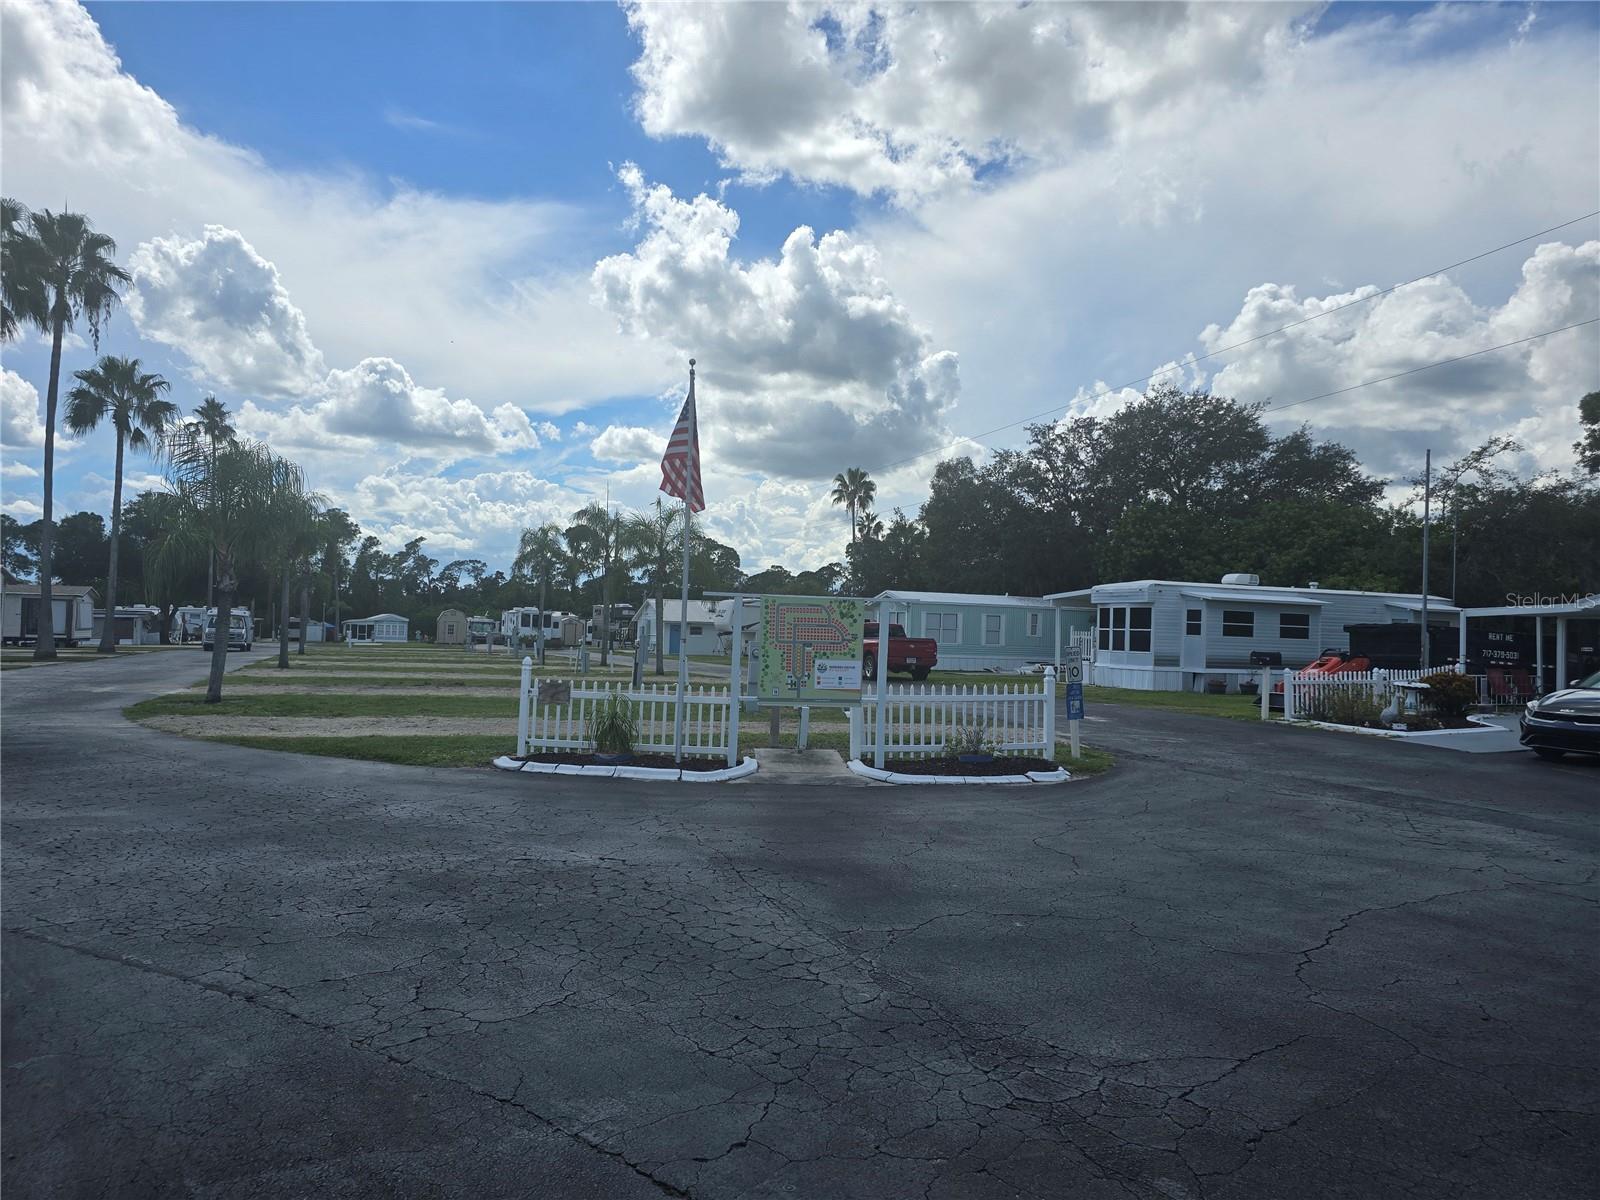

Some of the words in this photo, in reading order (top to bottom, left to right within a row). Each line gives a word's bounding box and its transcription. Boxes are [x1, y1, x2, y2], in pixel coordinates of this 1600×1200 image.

[1488, 633, 1503, 641] RENT
[1504, 634, 1514, 642] ME
[1068, 666, 1080, 678] 10
